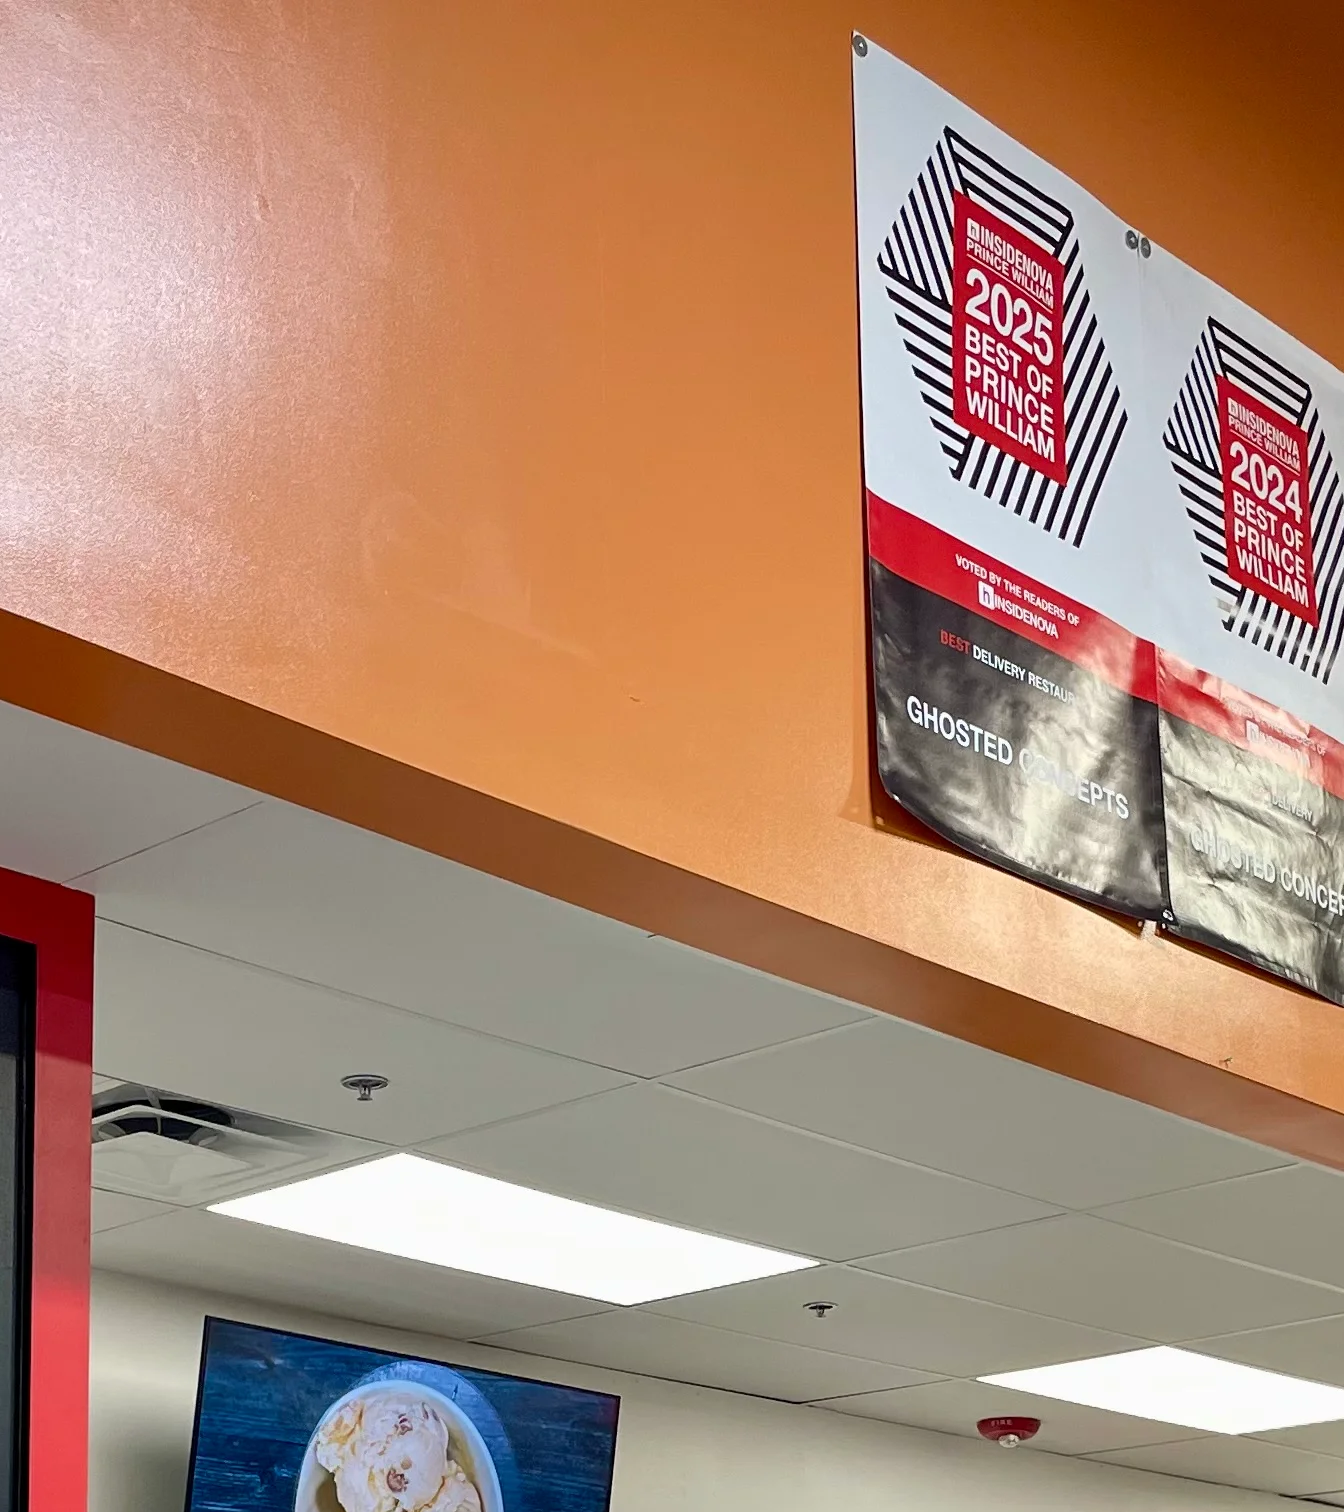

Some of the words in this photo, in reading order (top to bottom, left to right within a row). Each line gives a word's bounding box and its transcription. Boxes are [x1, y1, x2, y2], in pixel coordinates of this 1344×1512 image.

[966, 238, 1009, 277] PRINCE
[1011, 264, 1054, 309] WILLIAM
[980, 225, 1053, 295] INSIDENOVA
[965, 268, 1054, 366] 2025
[965, 323, 1022, 378] BEST
[1026, 364, 1054, 400] OF
[965, 354, 1055, 435] PRINCE
[965, 386, 1055, 463] WILLIAM
[1228, 414, 1263, 449] PRINCE
[1264, 437, 1301, 473] WILLIAM
[1238, 402, 1299, 460] INSIDENOVA
[1230, 441, 1303, 524] 2024
[1233, 489, 1278, 537] BEST
[1281, 525, 1304, 553] OF
[1233, 517, 1306, 583] PRINCE
[955, 554, 988, 580] VOTED
[988, 570, 1002, 586] BY
[1003, 579, 1022, 599] THE
[1023, 589, 1066, 621] READERS
[1067, 612, 1080, 627] OF
[1235, 544, 1309, 608] WILLIAM
[994, 594, 1059, 639] INSIDENOVA
[940, 629, 971, 655] BEST
[973, 645, 1026, 682] DELIVERY
[1028, 670, 1076, 706] RESTAUR
[906, 695, 1013, 767] GHOSTED
[1019, 747, 1129, 820] COEPTS
[1190, 827, 1276, 885] GHOSTED
